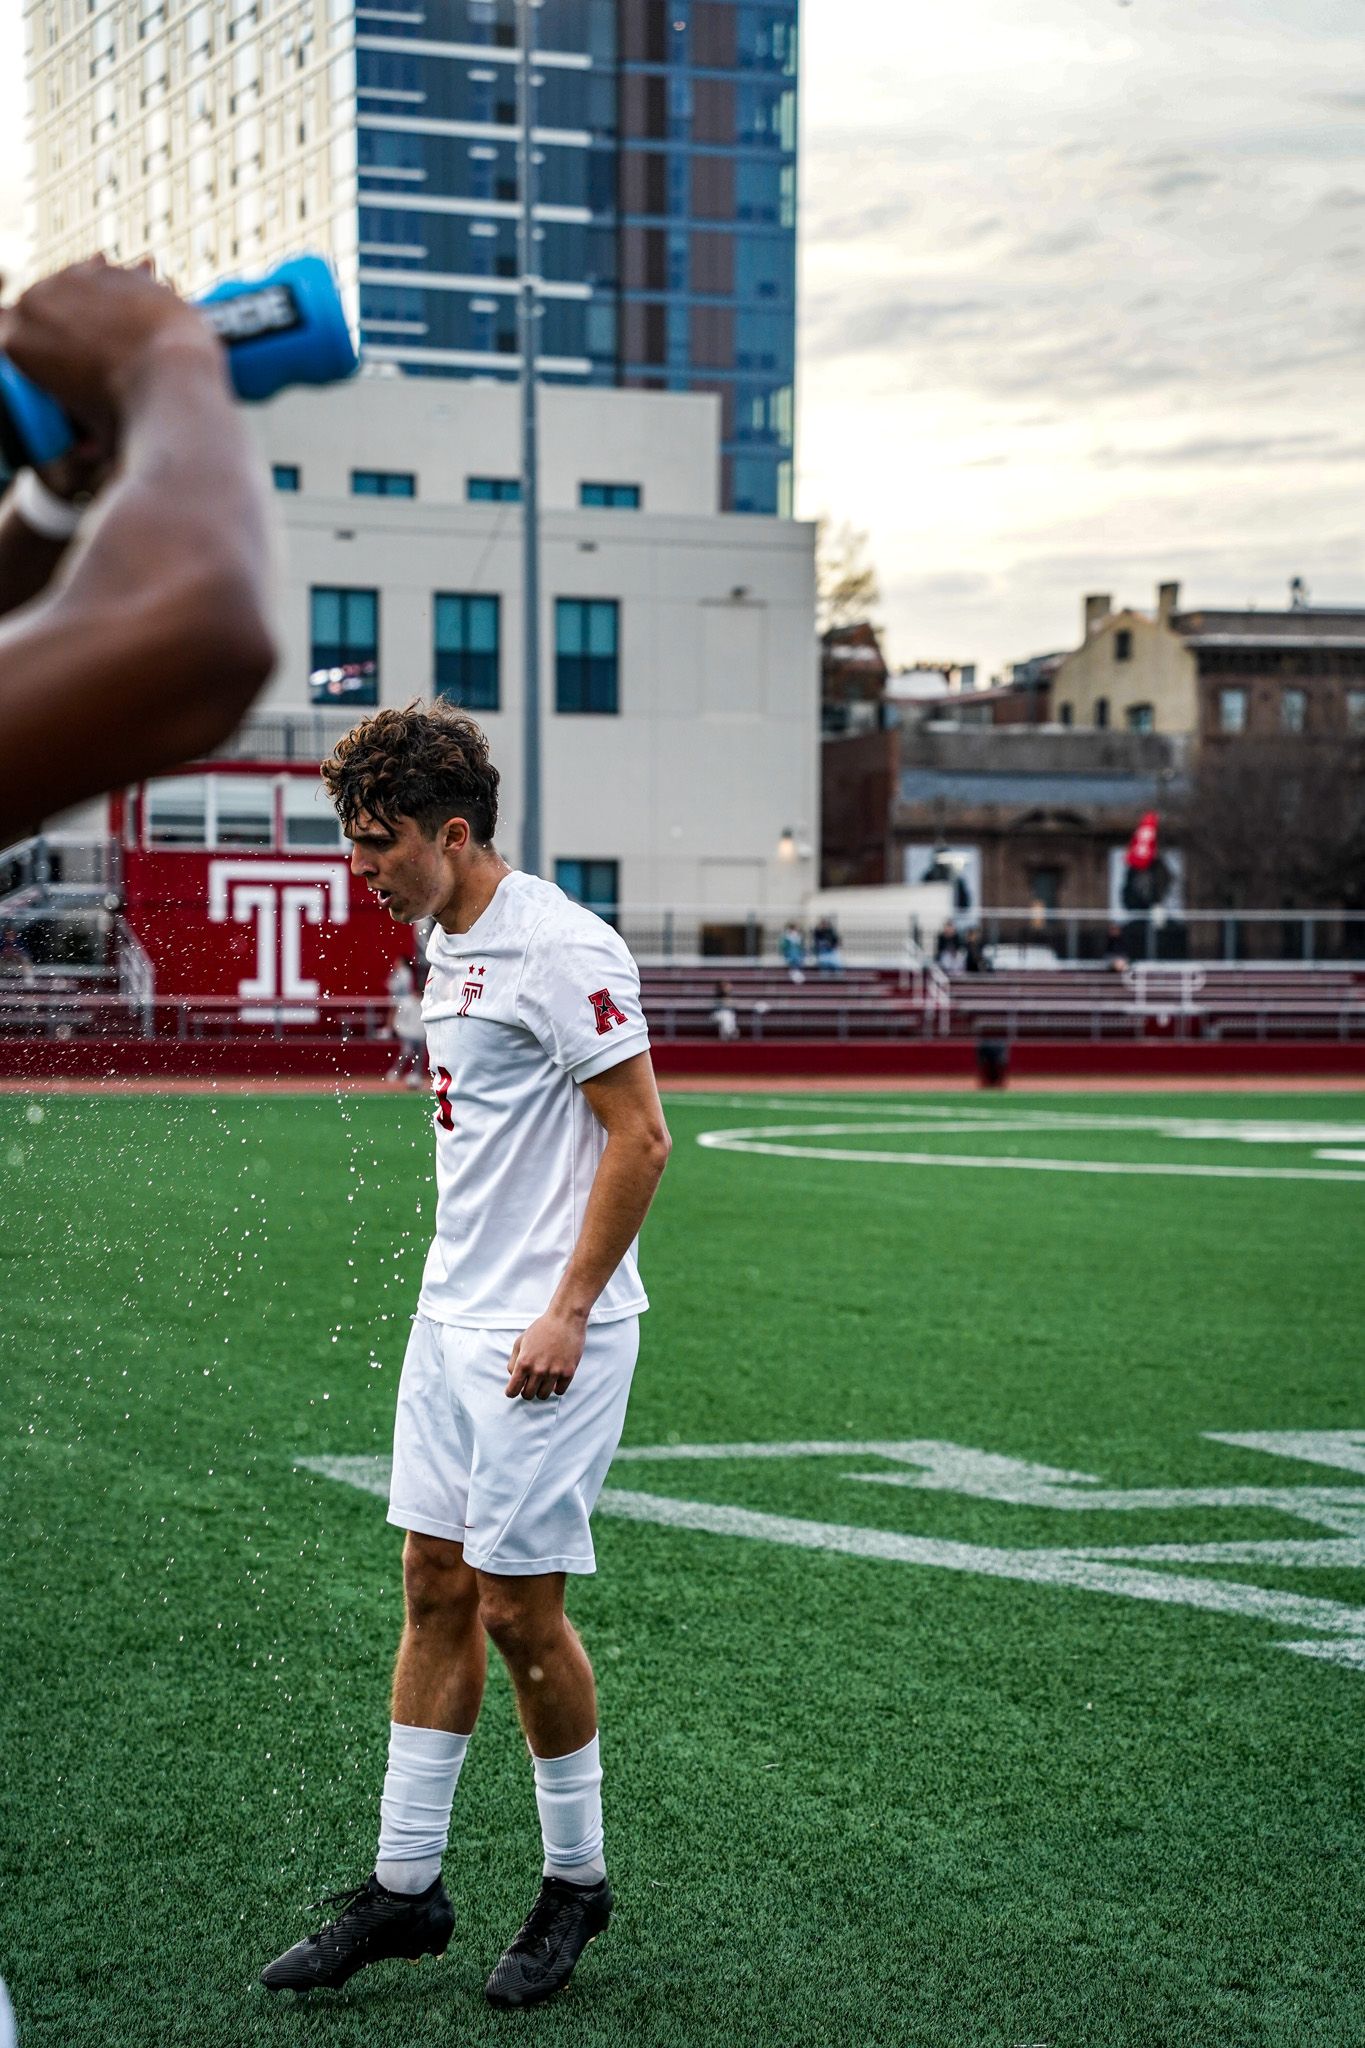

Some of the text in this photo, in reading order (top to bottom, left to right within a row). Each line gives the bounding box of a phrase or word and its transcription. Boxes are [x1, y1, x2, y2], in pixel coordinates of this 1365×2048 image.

[208, 860, 349, 1024] T
[457, 981, 484, 1017] T
[588, 988, 629, 1036] A
